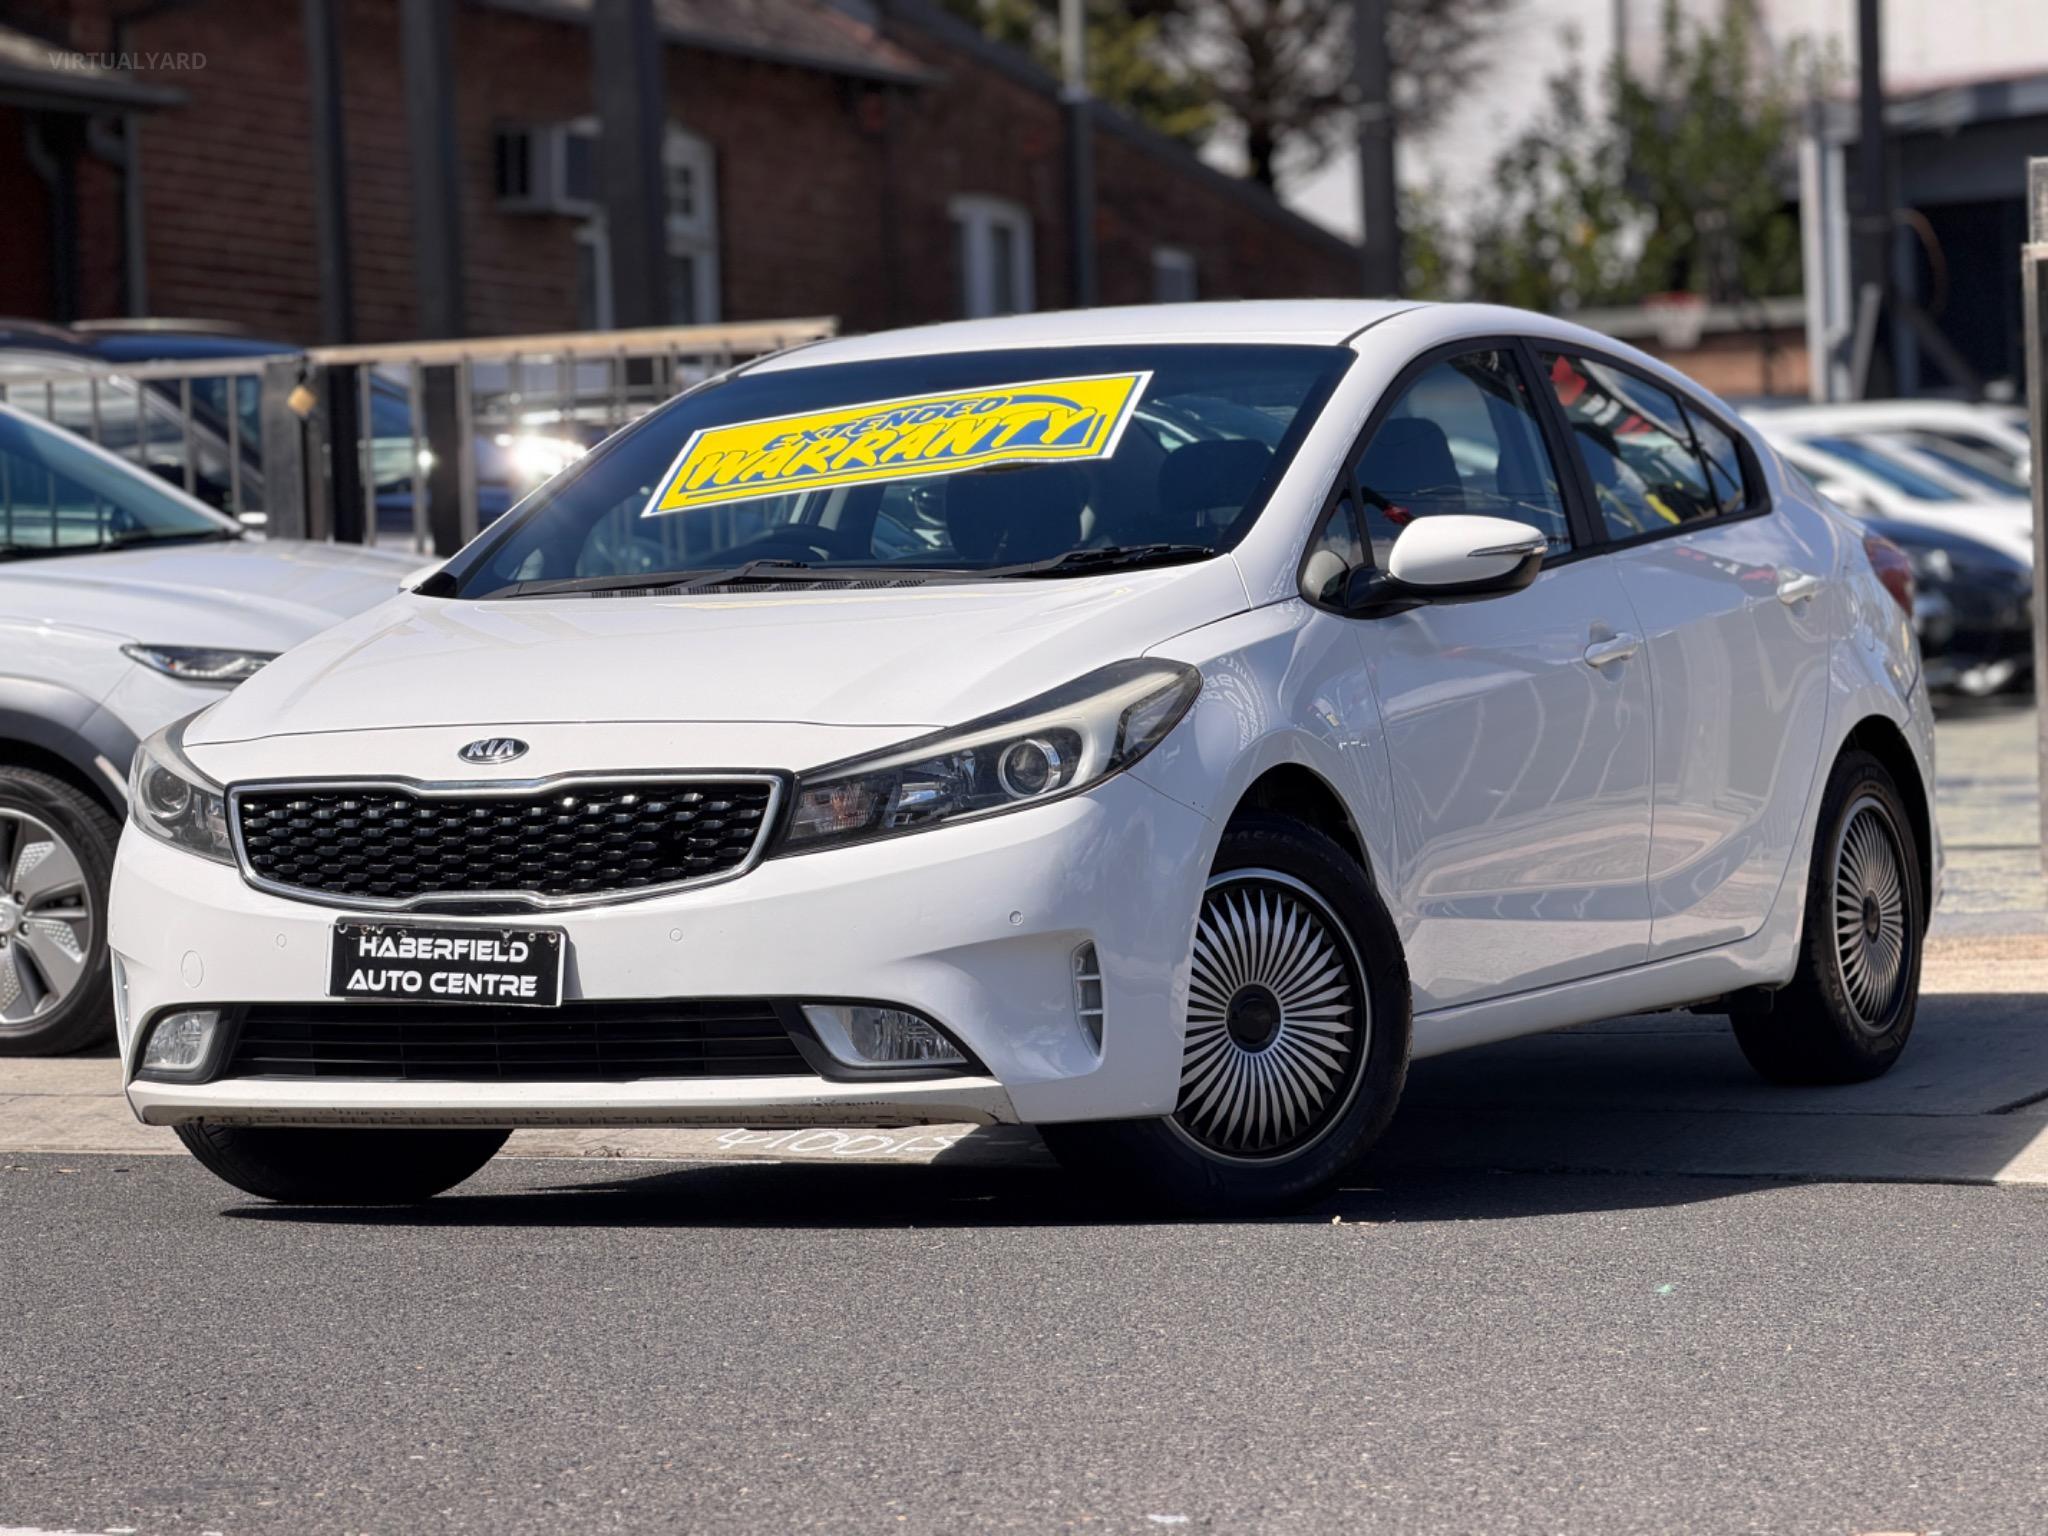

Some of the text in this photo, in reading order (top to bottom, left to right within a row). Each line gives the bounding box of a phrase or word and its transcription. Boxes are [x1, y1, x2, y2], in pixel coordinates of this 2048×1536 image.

[762, 396, 1013, 452] EXTENDED
[685, 407, 1099, 491] WARRANTY
[466, 738, 516, 758] KIA
[358, 936, 530, 963] HABERFIELD
[346, 968, 539, 997] AUTO CENTRE
